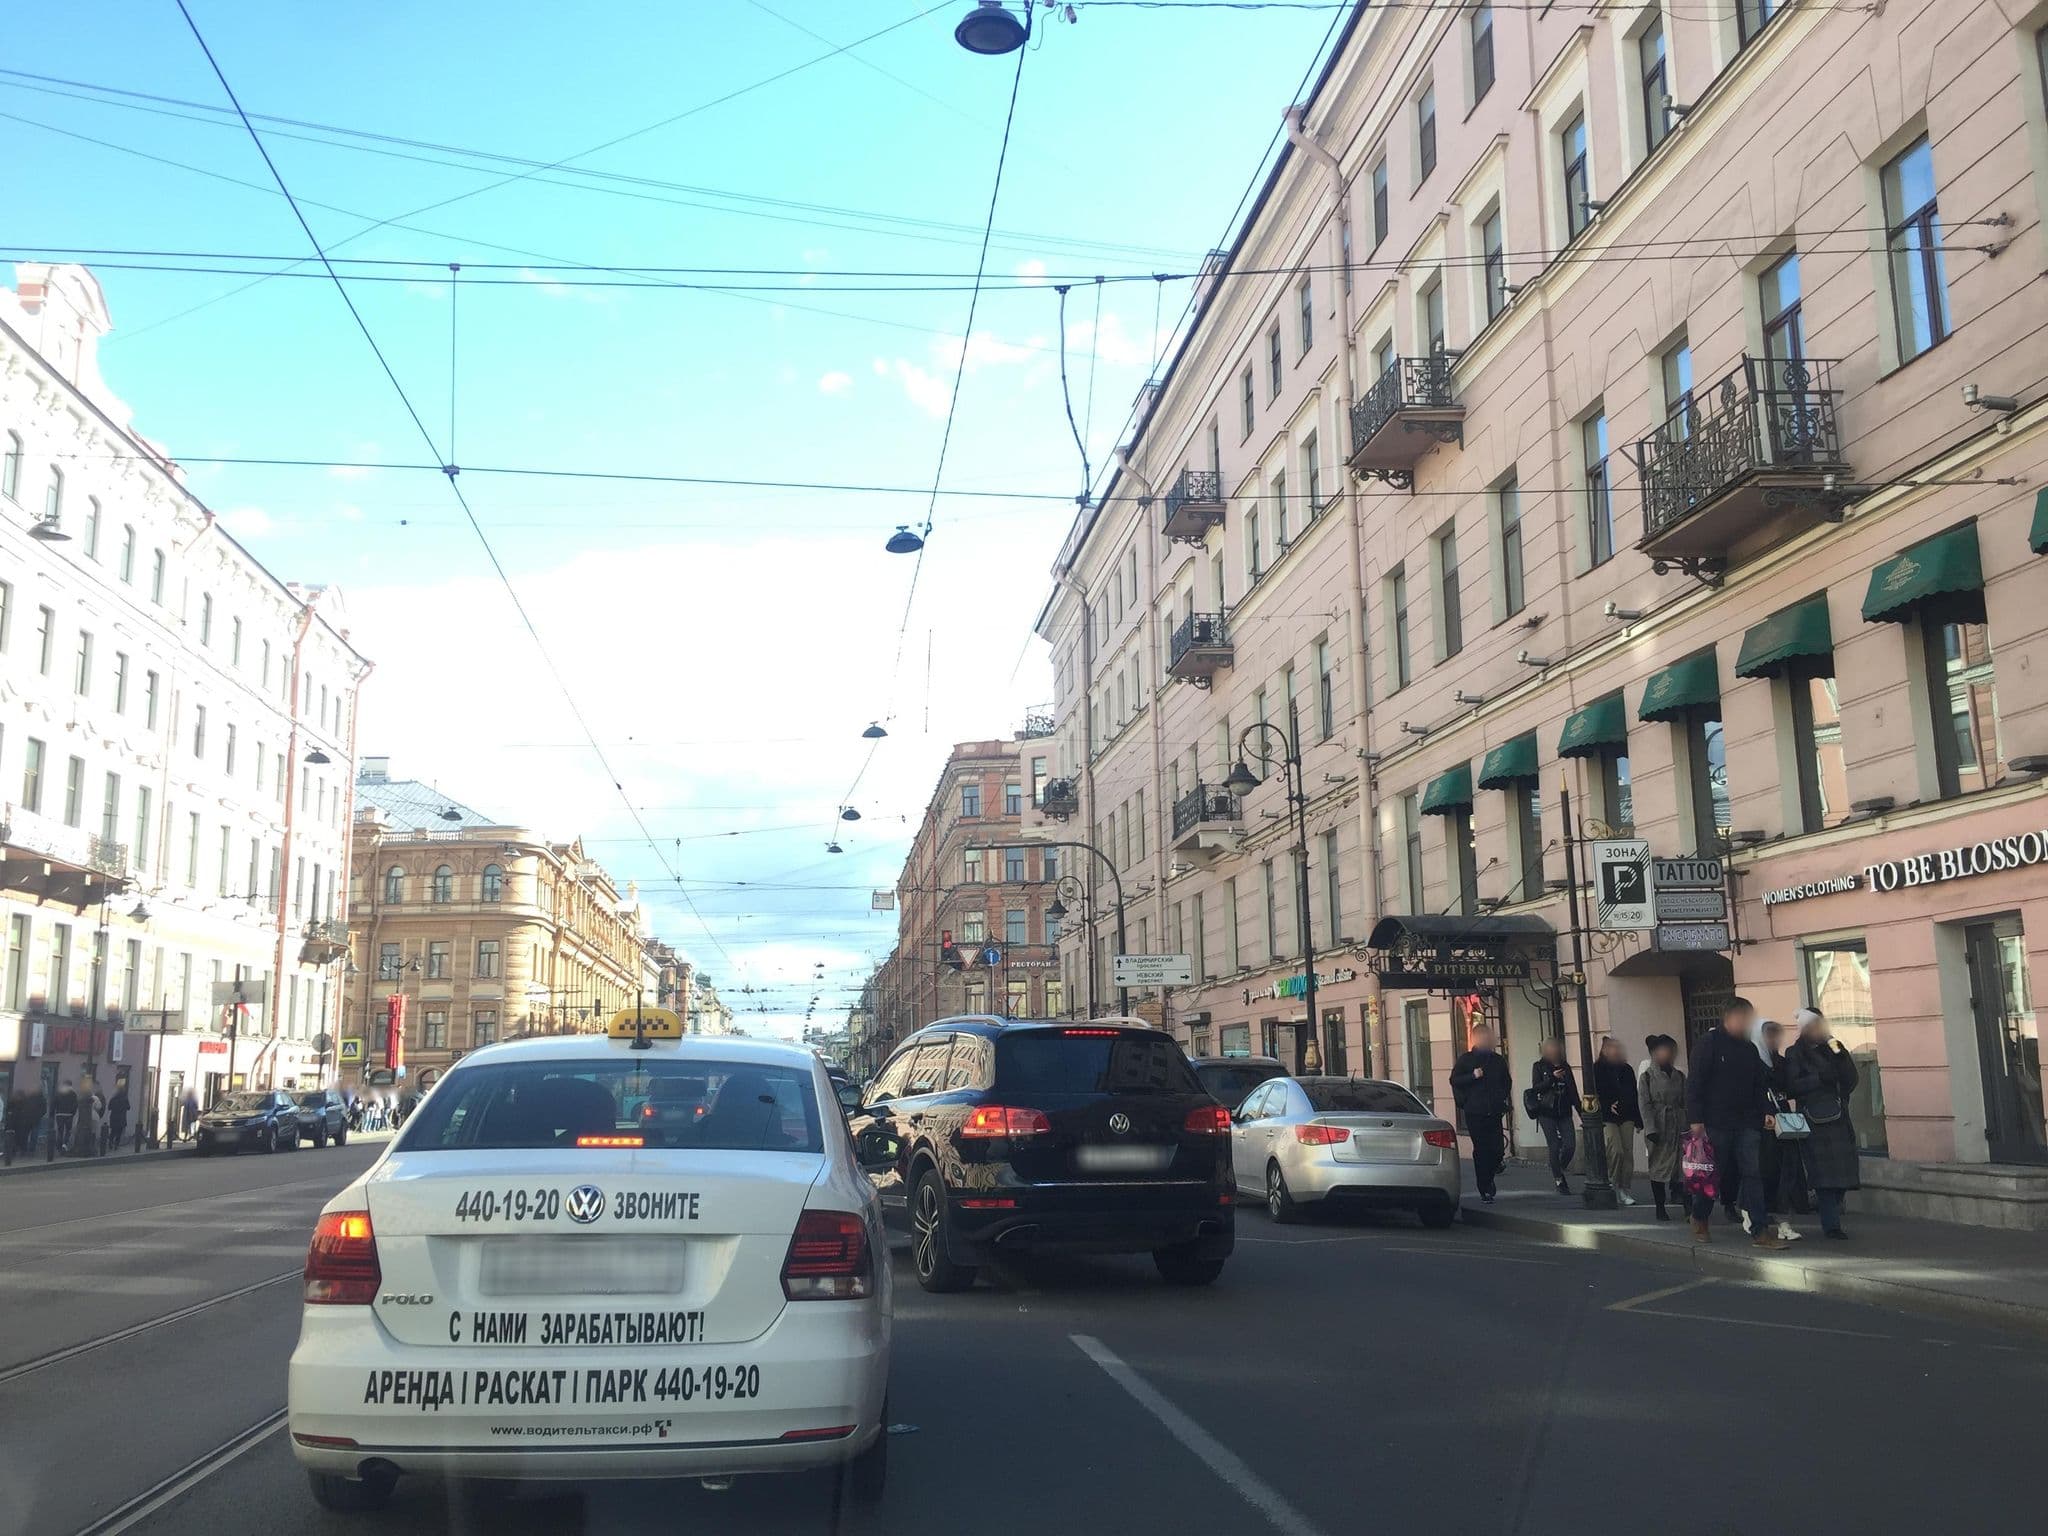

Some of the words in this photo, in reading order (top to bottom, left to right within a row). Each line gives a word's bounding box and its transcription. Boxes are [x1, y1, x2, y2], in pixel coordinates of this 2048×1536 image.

[1605, 847, 1638, 858] ЗОНА
[1656, 862, 1719, 881] TATTOO
[1864, 861, 1898, 892] TO
[1902, 854, 1936, 887] BE
[1761, 885, 1805, 905] WOMEN'S
[1805, 875, 1855, 897] CLOTHING
[1621, 911, 1628, 919] 15
[1630, 911, 1640, 920] 20
[1434, 964, 1522, 975] PITERSKAYA
[456, 1189, 560, 1222] 440-19-20
[614, 1192, 700, 1219] ЗВОНИТЕ
[382, 1294, 434, 1305] POLO
[450, 1311, 461, 1343] С
[473, 1312, 527, 1344] НАМИ
[540, 1311, 705, 1344] ЗАРАБАТЫВАЮТ!
[364, 1371, 454, 1412] АРЕНДА
[474, 1371, 567, 1405] РАСКАТ
[585, 1368, 648, 1403] ПАРК
[654, 1364, 760, 1401] 440-19-20
[490, 1423, 653, 1437] www.водительтакси.рф
